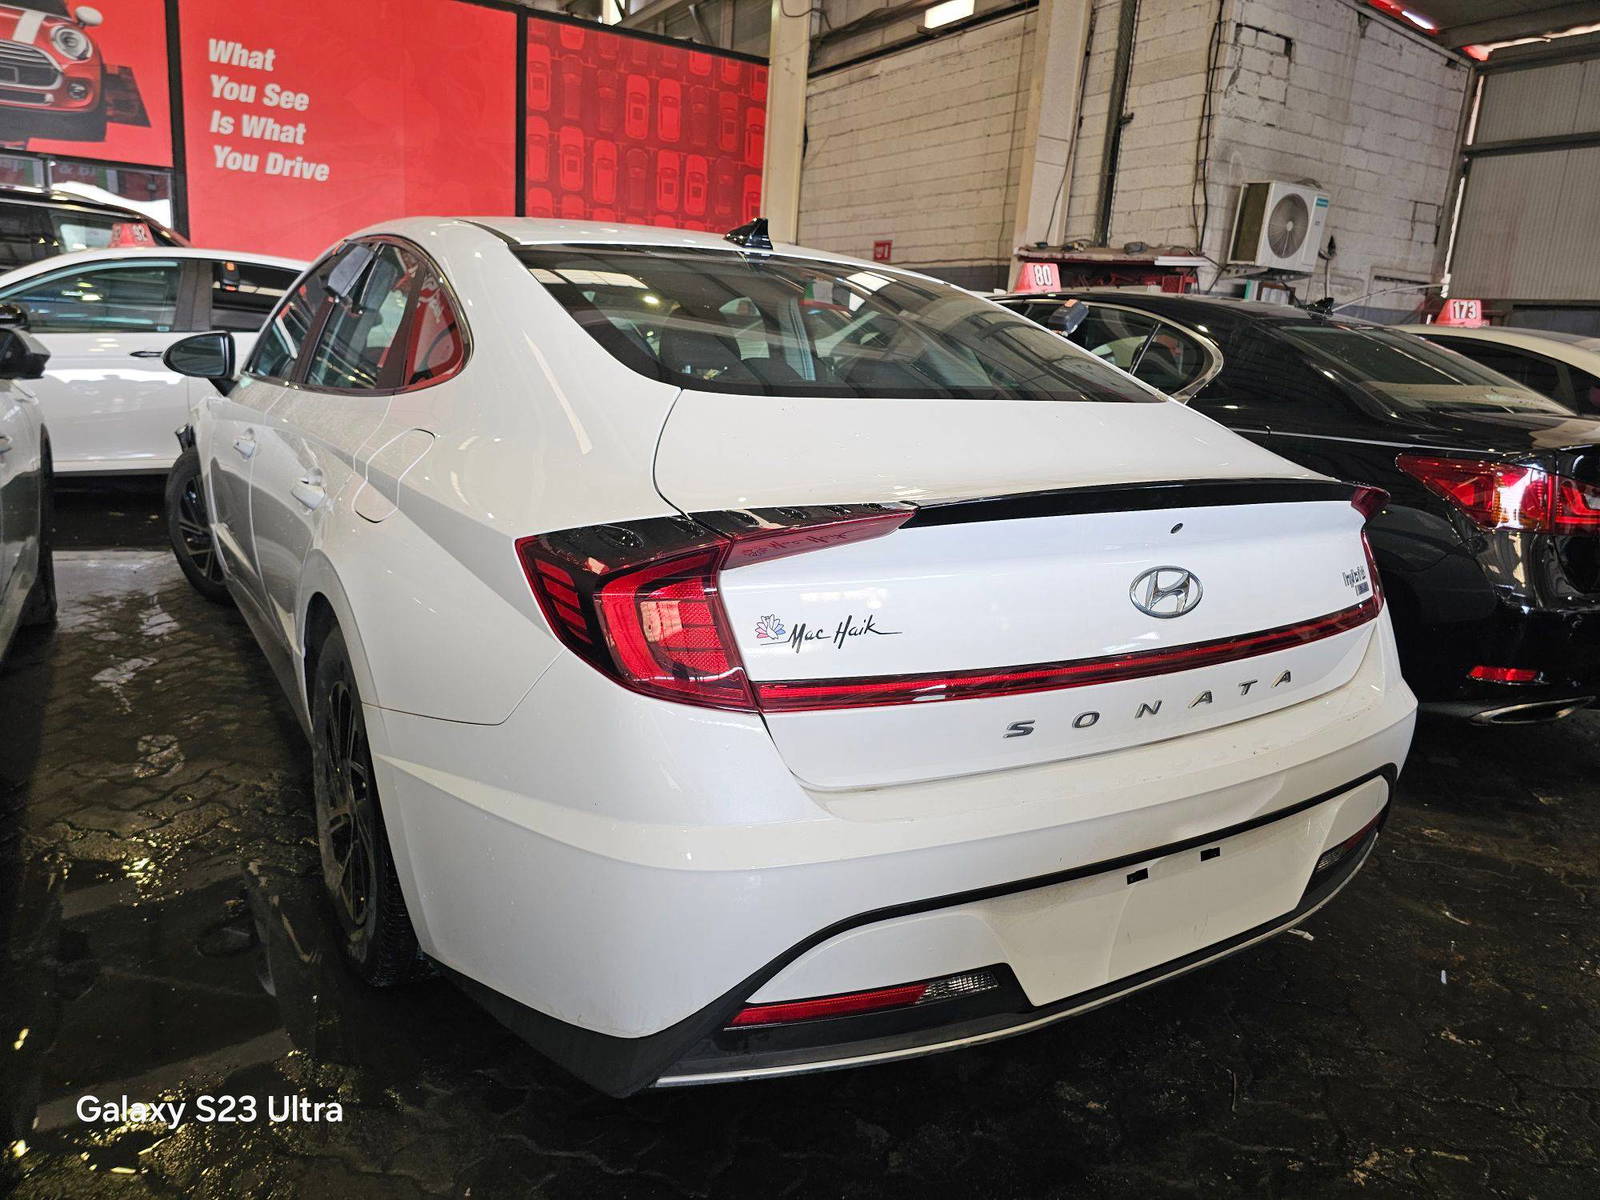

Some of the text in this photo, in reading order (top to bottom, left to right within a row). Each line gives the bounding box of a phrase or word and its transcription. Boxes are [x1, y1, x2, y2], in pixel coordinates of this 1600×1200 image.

[208, 38, 276, 72] What
[210, 74, 310, 111] You See
[209, 109, 307, 145] Is What
[213, 144, 330, 182] You Drive
[1033, 264, 1053, 287] 80
[1453, 301, 1477, 320] 173
[760, 614, 903, 654] Mac Haik
[1002, 669, 1292, 738] SONATA
